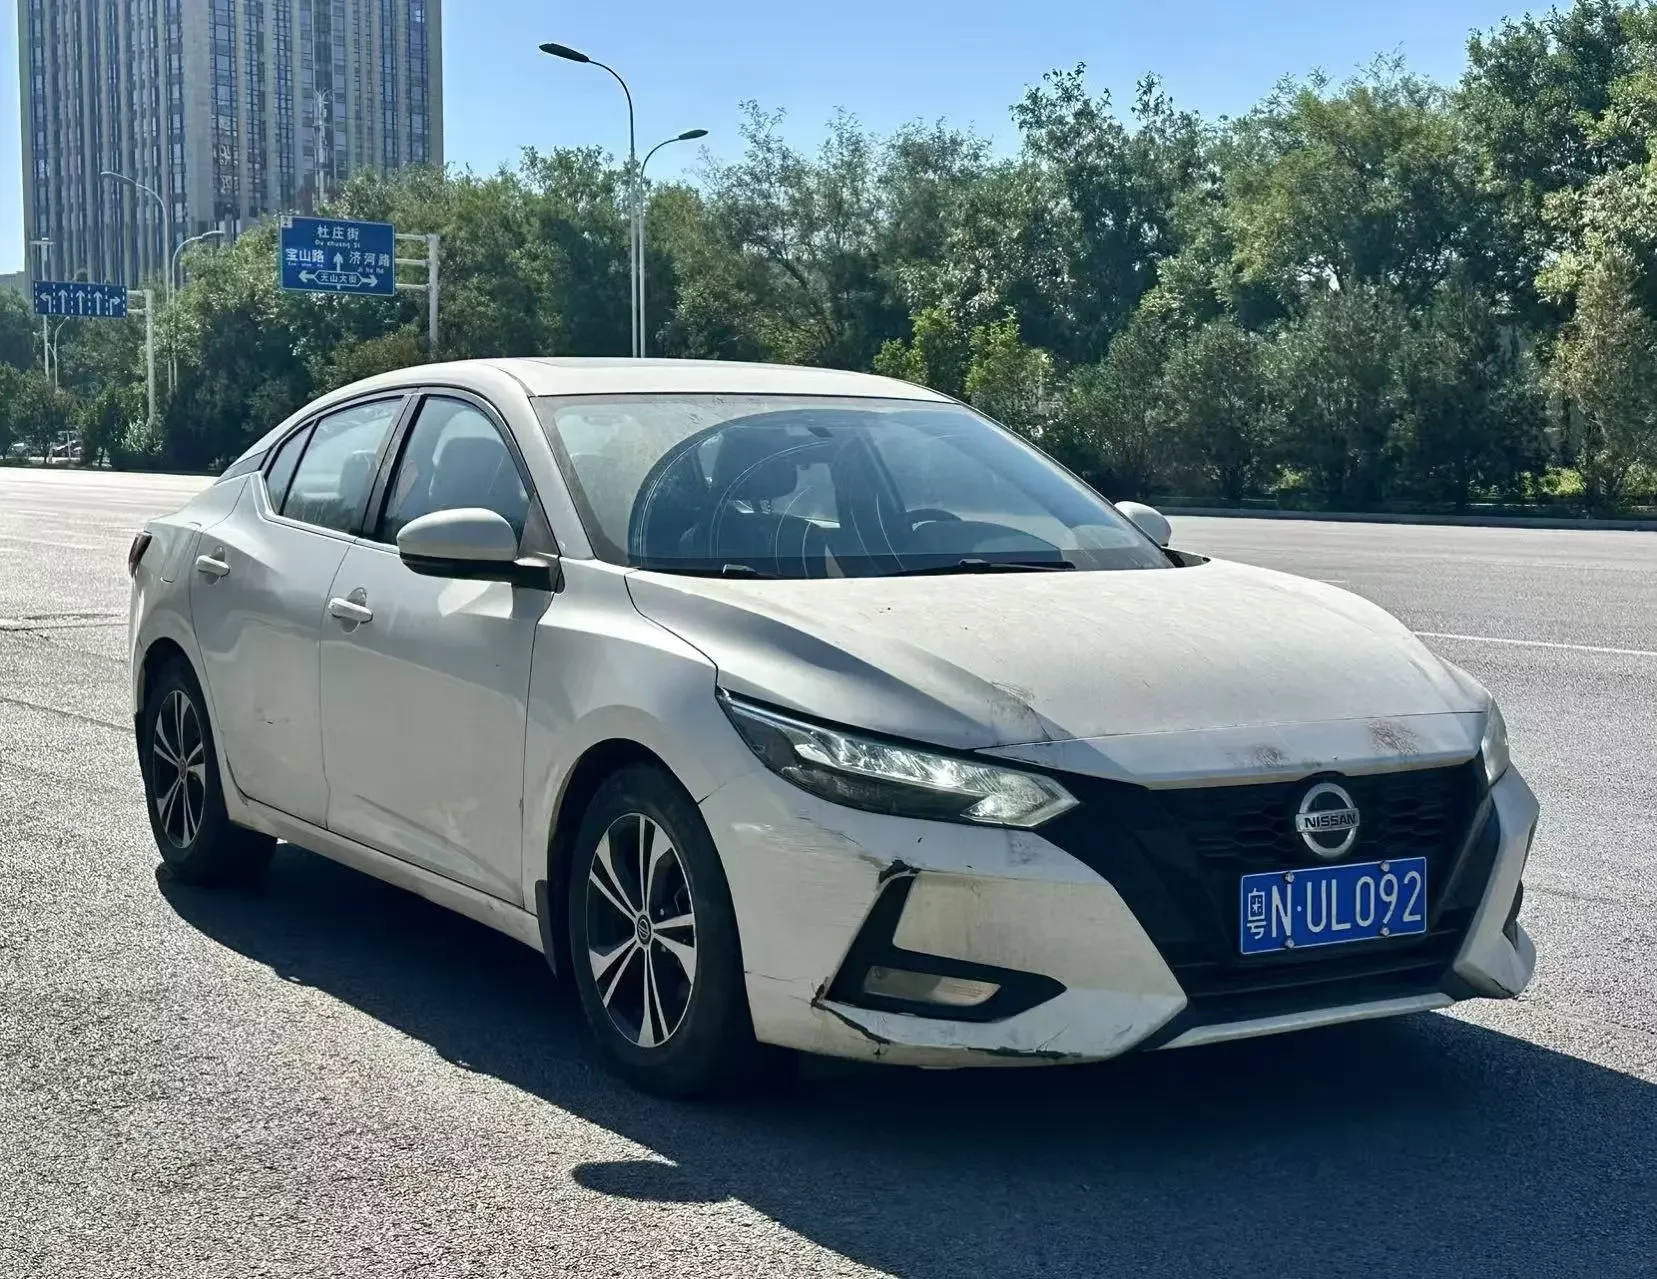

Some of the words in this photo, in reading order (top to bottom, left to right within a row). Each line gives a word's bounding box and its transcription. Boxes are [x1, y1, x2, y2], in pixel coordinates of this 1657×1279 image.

[316, 224, 360, 241] 杜庄街
[285, 247, 325, 263] 宝山路
[349, 250, 391, 267] 济河路
[1304, 814, 1357, 829] NISSAN
